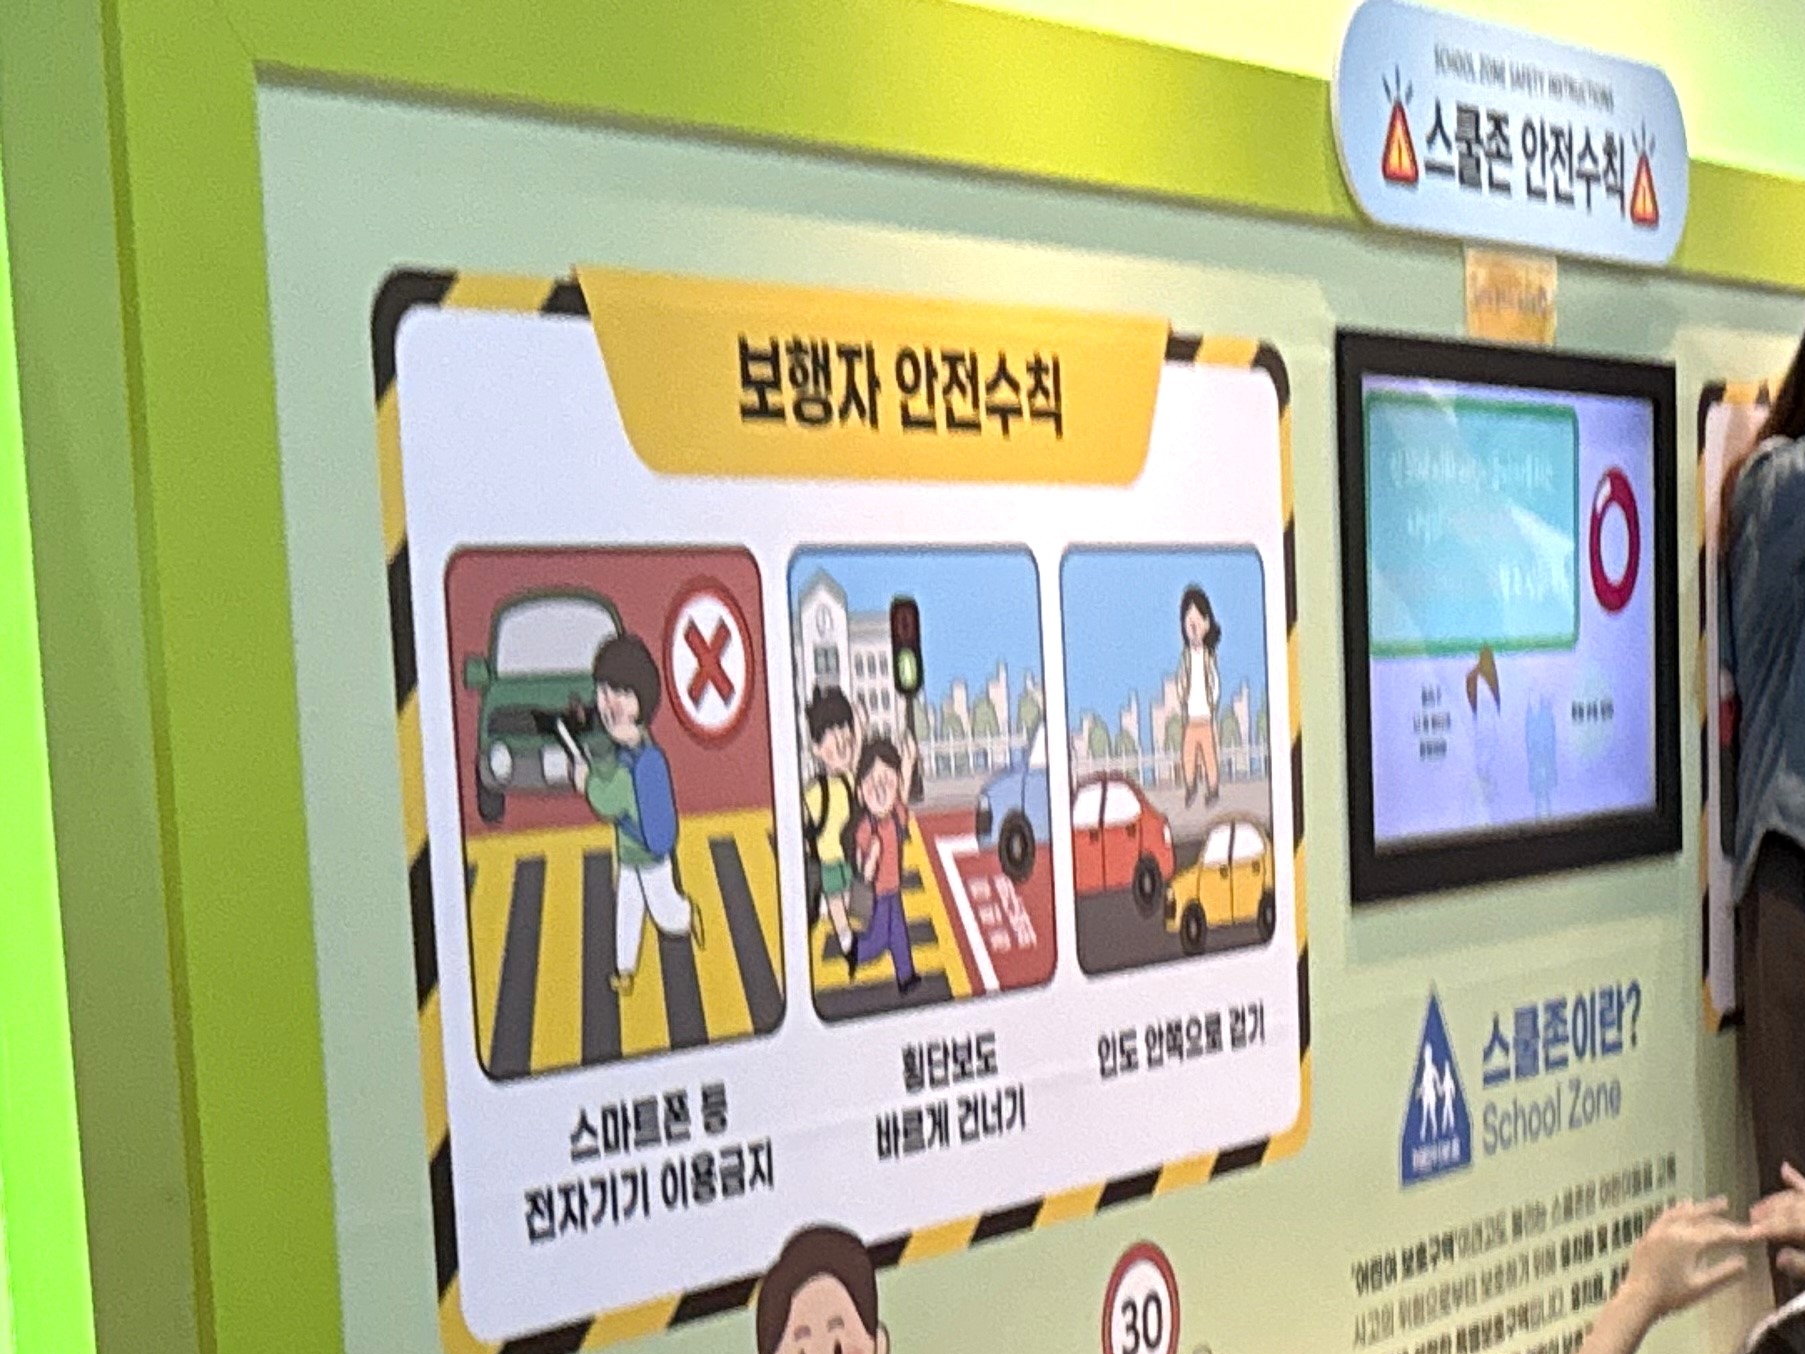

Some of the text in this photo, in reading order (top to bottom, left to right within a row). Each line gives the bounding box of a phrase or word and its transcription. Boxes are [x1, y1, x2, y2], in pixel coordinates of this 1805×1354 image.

[1424, 97, 1626, 218] 스쿨존 안전수칙
[738, 332, 1063, 440] 보행자 안전수칙
[902, 1030, 998, 1094] 횡단보도
[1098, 1000, 1265, 1078] 인도 안쪽으로 걷기
[1482, 980, 1641, 1088] 스쿨존이란?
[570, 1081, 727, 1162] 스마트폰 등
[876, 1083, 1026, 1161] 바르게 건너기
[1482, 1078, 1622, 1154] School Zone
[524, 1136, 774, 1244] 전자기기 이용금지
